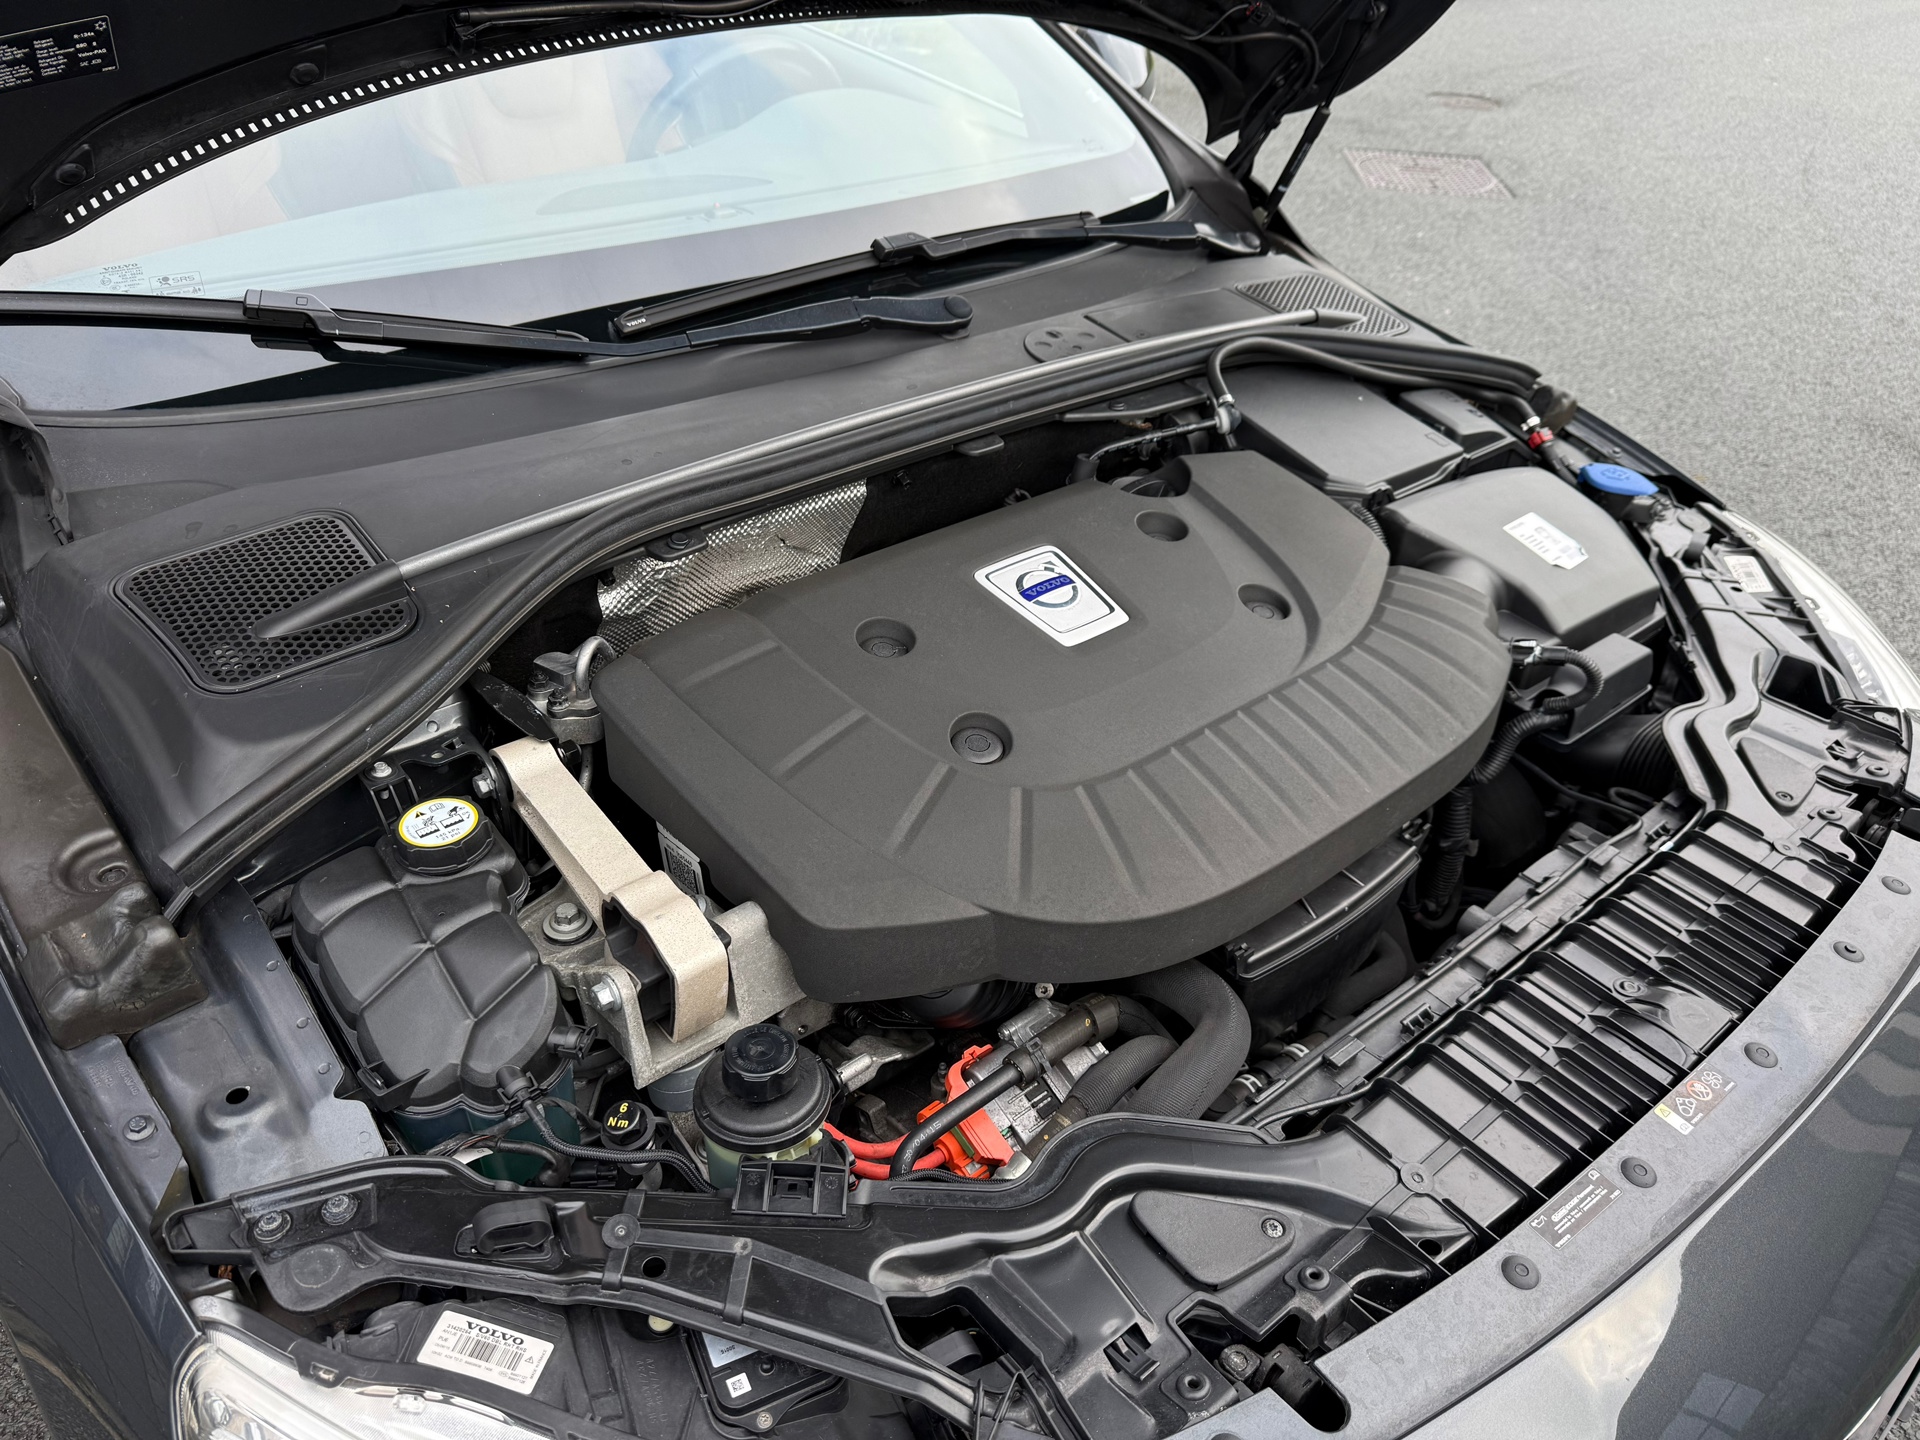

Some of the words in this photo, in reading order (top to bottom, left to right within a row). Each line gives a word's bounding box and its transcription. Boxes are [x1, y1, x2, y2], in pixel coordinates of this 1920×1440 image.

[102, 262, 138, 271] VOLVO
[172, 274, 195, 283] SRS
[626, 317, 647, 327] VOLVO
[1025, 576, 1070, 597] VOLVO
[619, 1102, 629, 1113] 6
[607, 1117, 630, 1129] Nm
[466, 1320, 525, 1346] VOLVO
